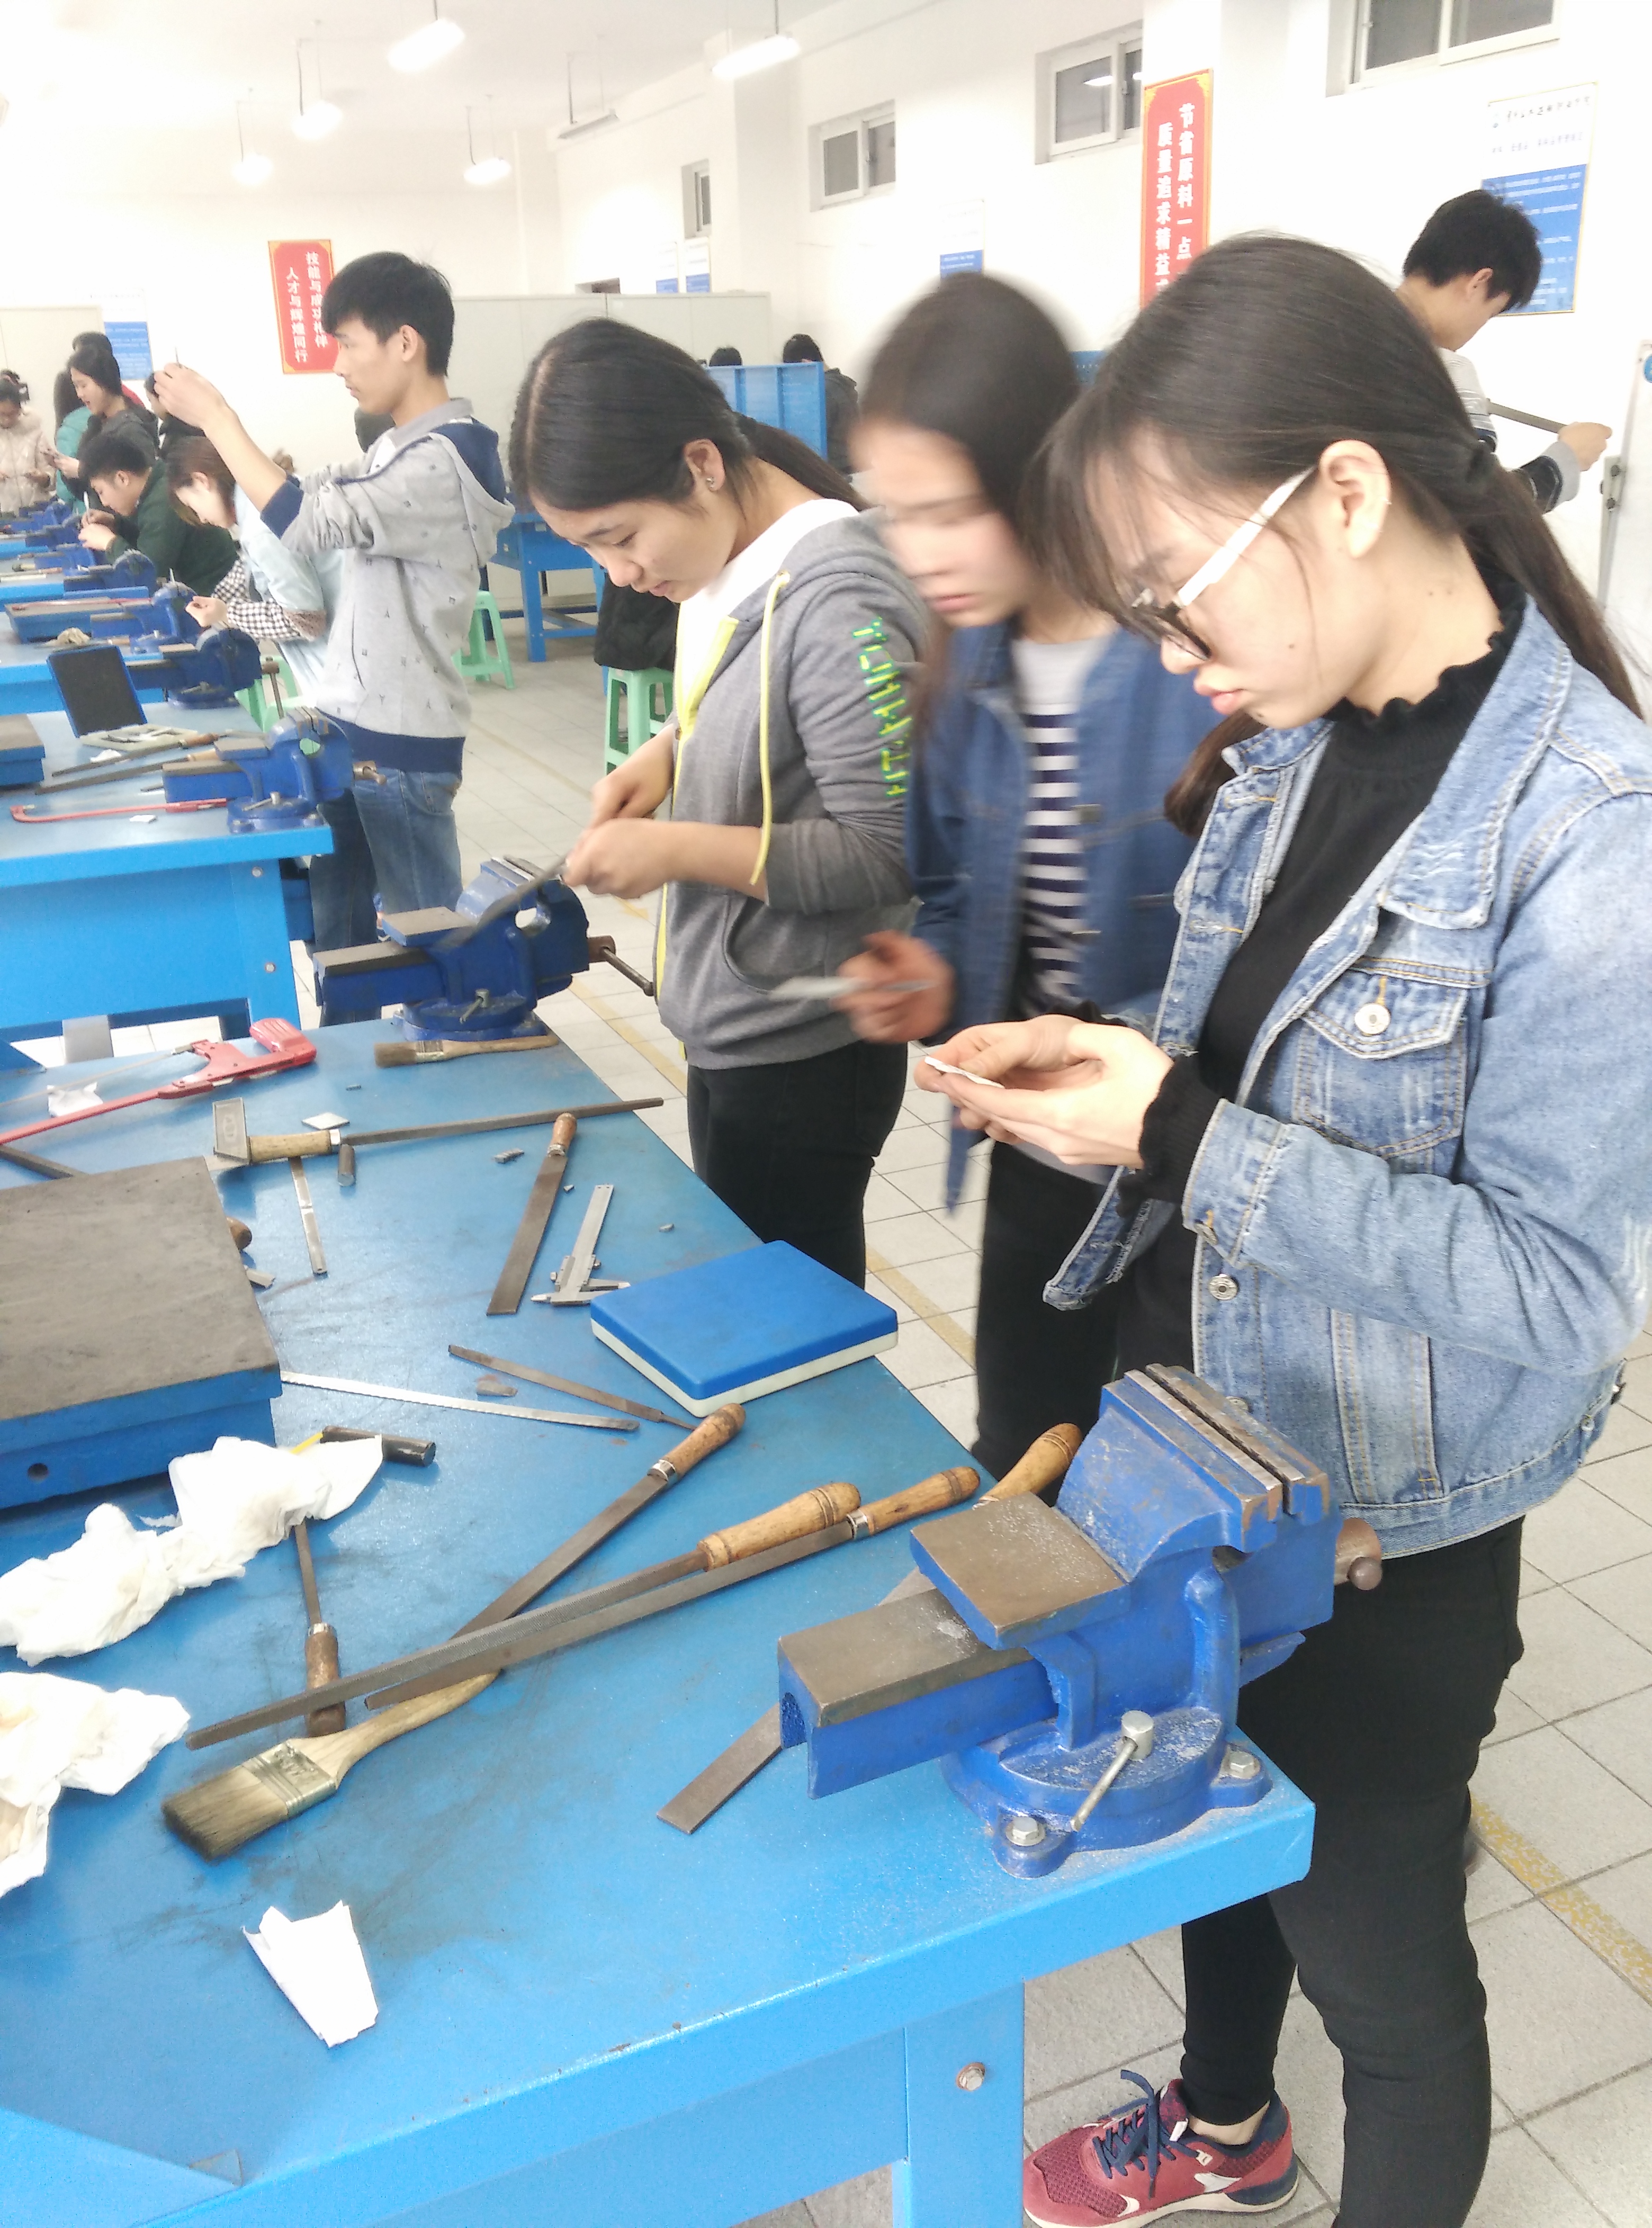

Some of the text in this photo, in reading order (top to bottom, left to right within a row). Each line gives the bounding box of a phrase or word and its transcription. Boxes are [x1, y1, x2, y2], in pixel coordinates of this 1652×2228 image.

[1155, 121, 1173, 286] 质量追求精益
[286, 266, 308, 363] 人才与辉煌同行
